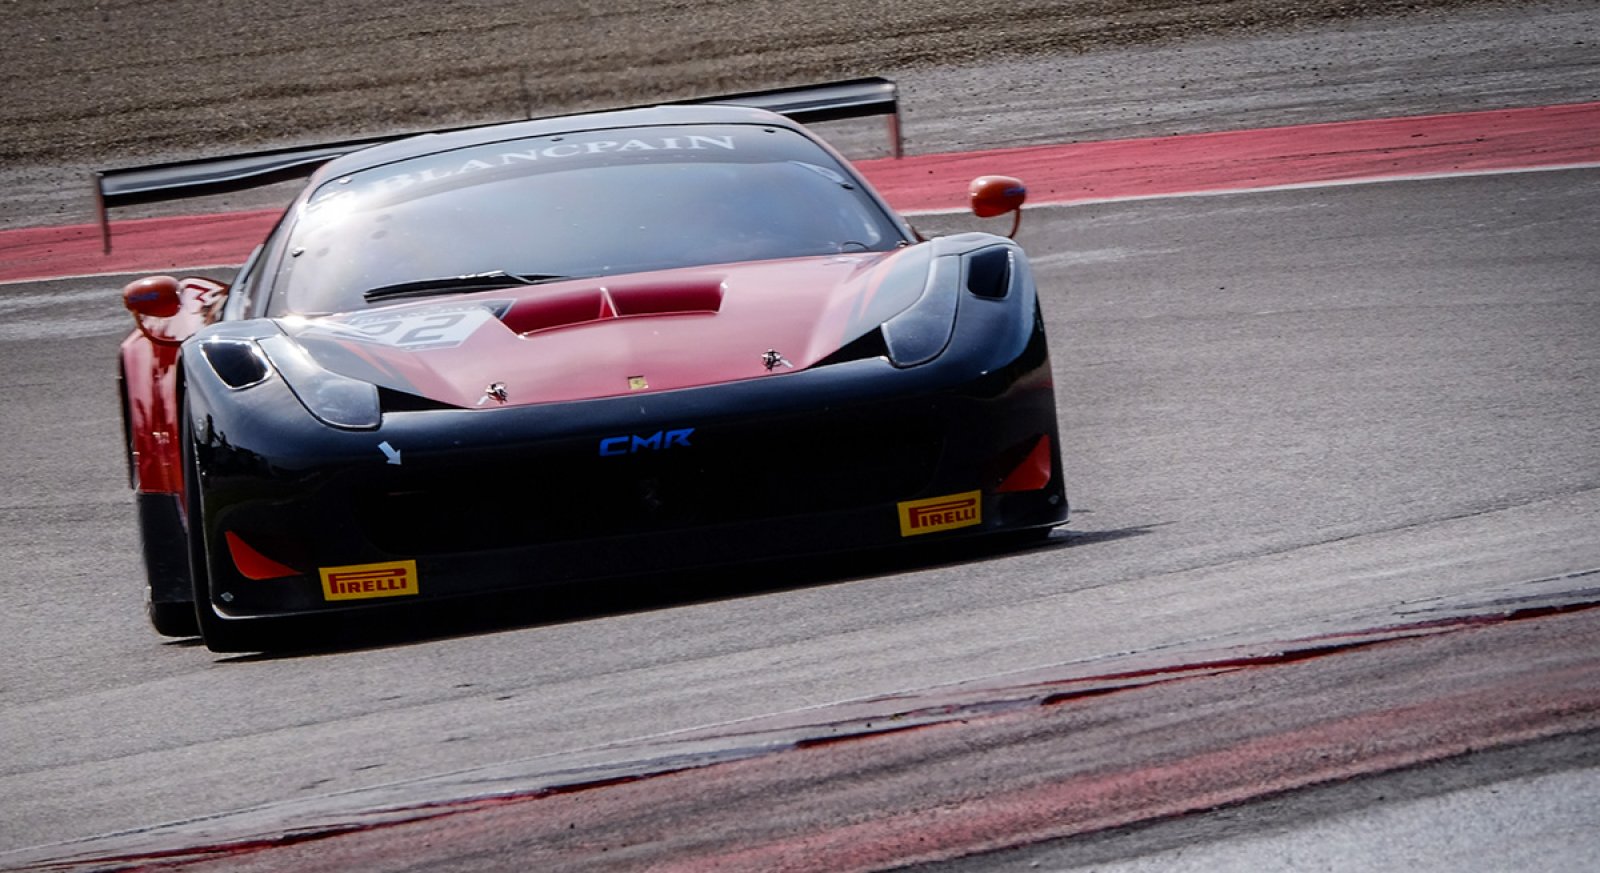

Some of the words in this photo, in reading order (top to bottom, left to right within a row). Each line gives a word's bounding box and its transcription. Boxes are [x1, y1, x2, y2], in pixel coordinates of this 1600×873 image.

[373, 135, 736, 191] BLANCPAIN
[600, 428, 695, 456] CMR
[908, 498, 977, 529] PIRELLI
[328, 568, 407, 594] PIRELLI
